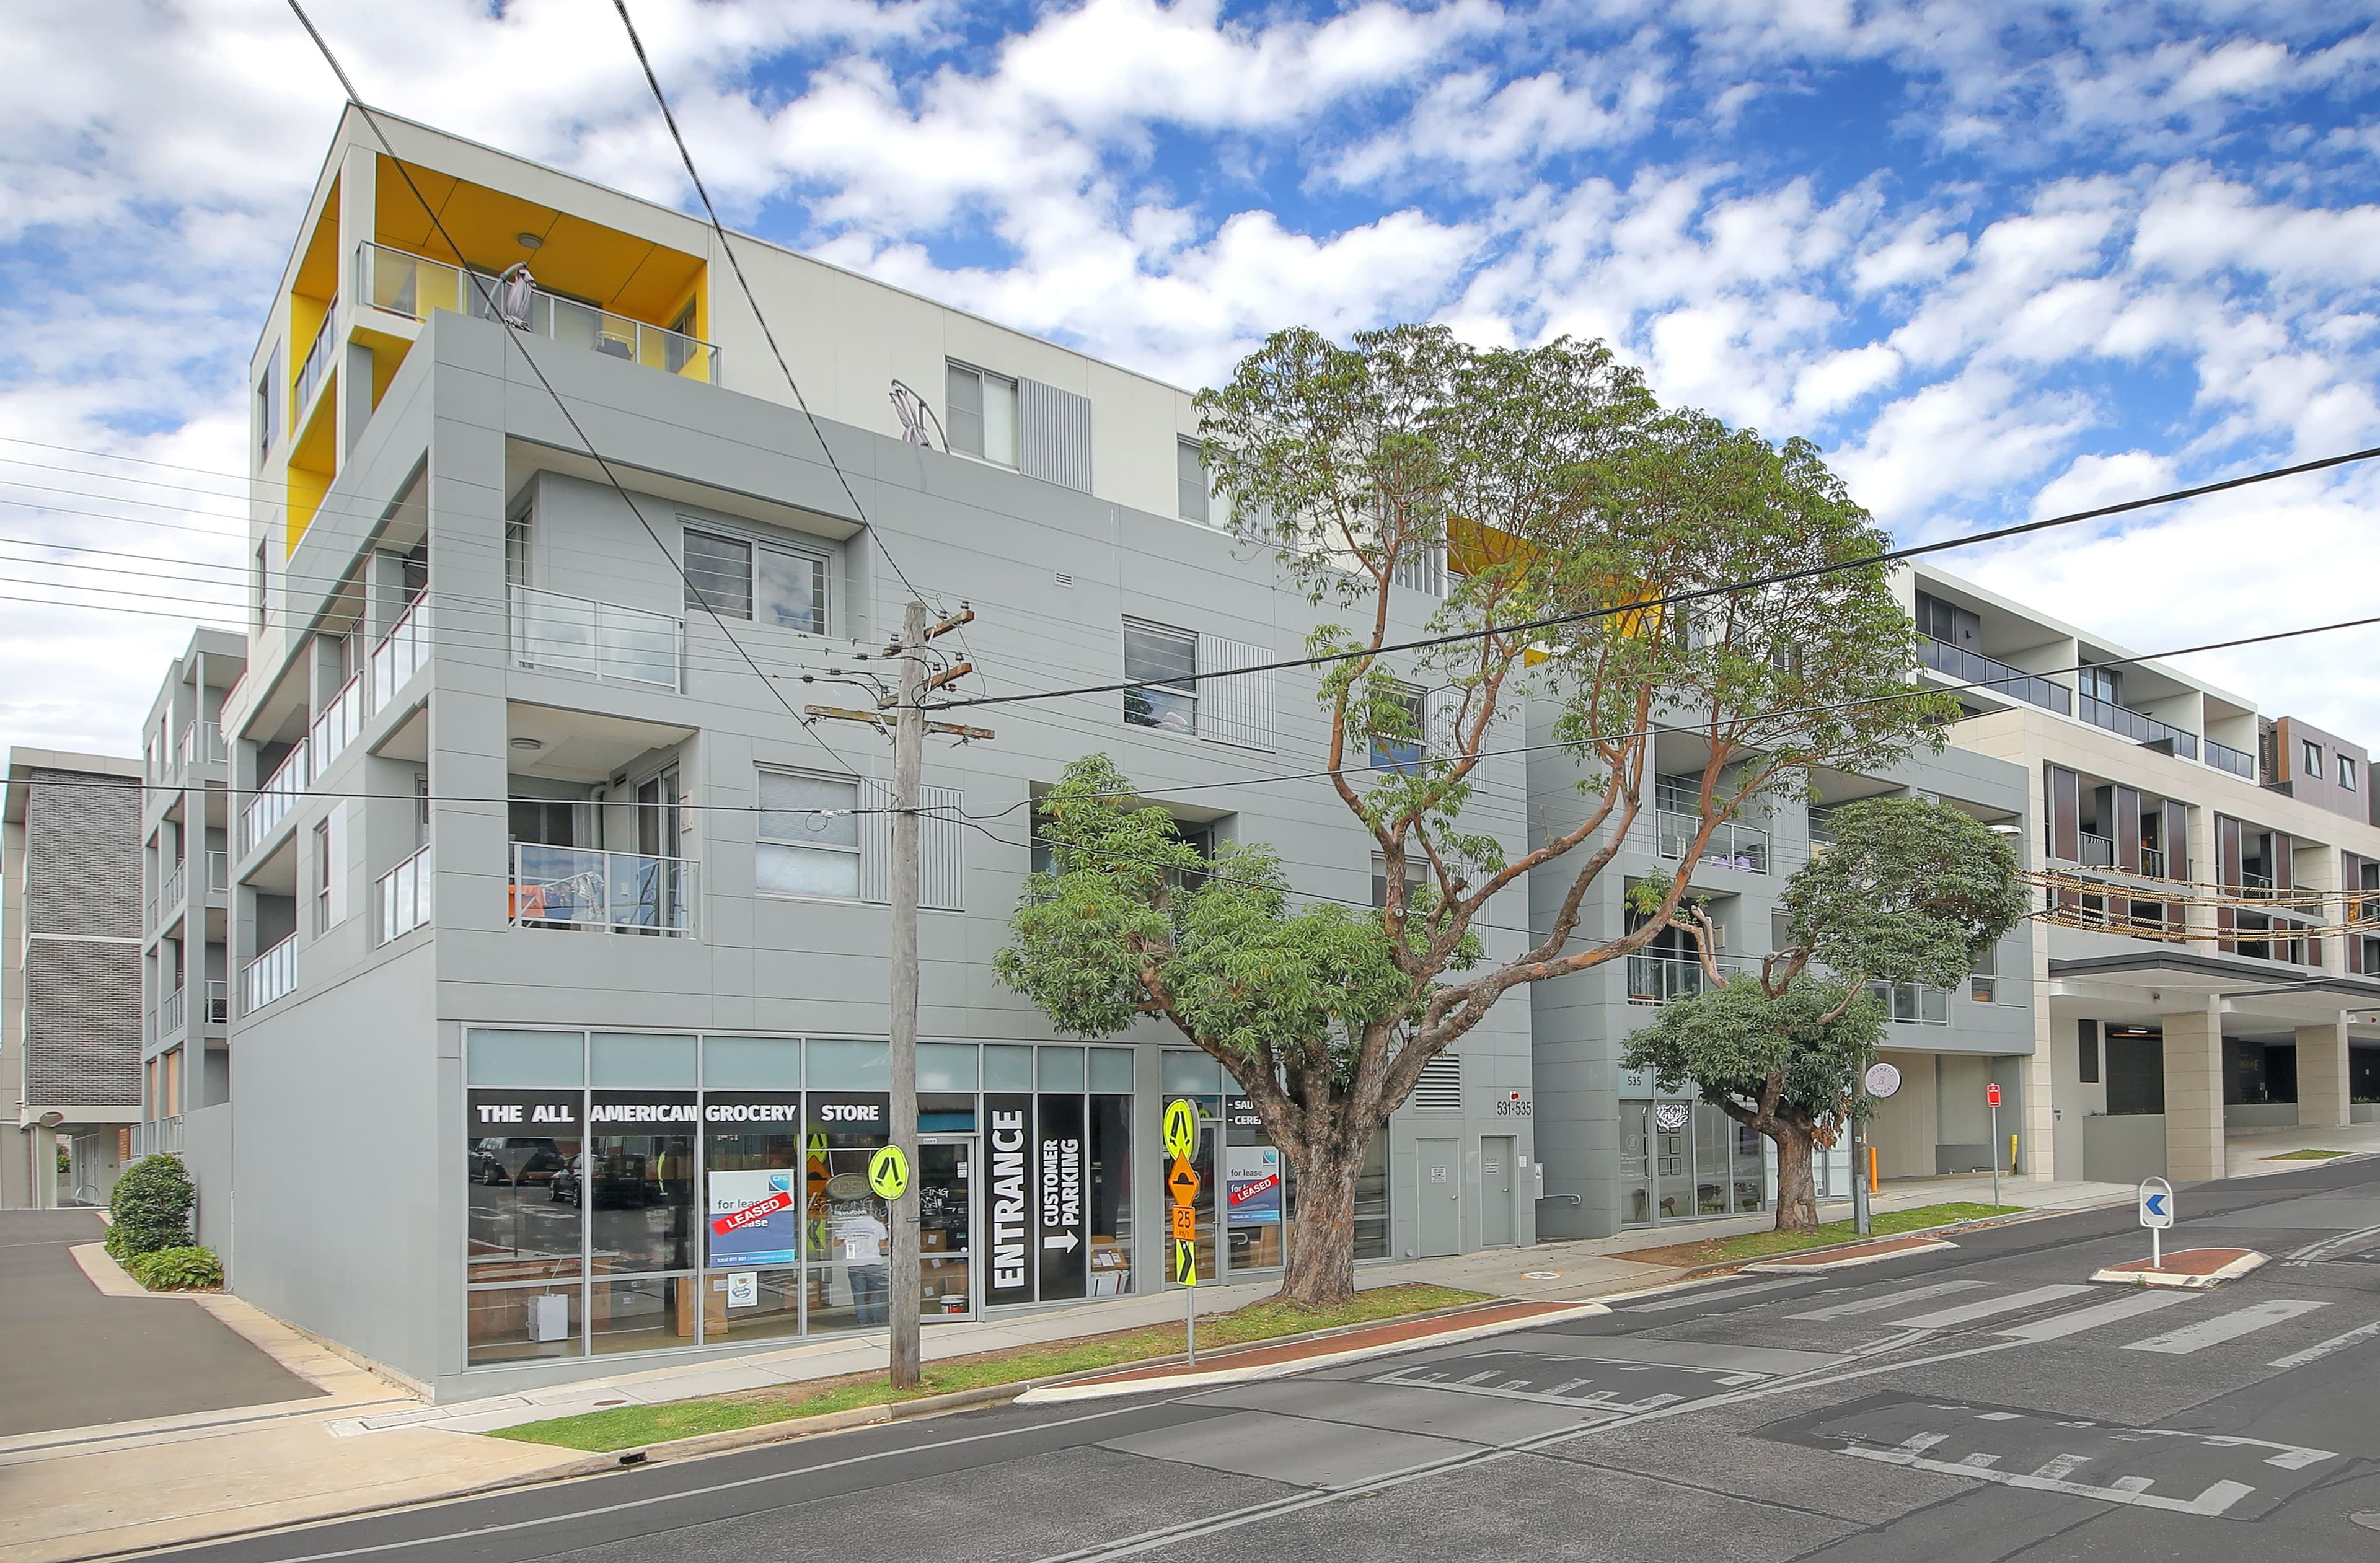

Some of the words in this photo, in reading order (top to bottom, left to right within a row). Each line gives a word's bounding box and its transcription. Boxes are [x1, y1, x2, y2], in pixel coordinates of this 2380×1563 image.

[1628, 1076, 1642, 1086] 535
[1869, 1068, 1895, 1078] COSMETIC
[1869, 1085, 1893, 1094] DOCTORS
[476, 1104, 524, 1122] THE
[531, 1104, 575, 1122] ALL
[589, 1104, 697, 1122] AMERICAN
[705, 1104, 798, 1122] GROCERY
[821, 1104, 879, 1121] STORE
[1497, 1101, 1532, 1116] 531-535
[1231, 1169, 1241, 1177] for
[1042, 1138, 1059, 1227] CUSTOMER
[1060, 1138, 1080, 1226] PARKING
[1231, 1184, 1242, 1193] for
[1237, 1179, 1272, 1201] LEASED
[717, 1199, 734, 1209] for
[992, 1109, 1025, 1289] ENTRANCE
[725, 1199, 780, 1228] LEASED
[1178, 1210, 1191, 1228] 25
